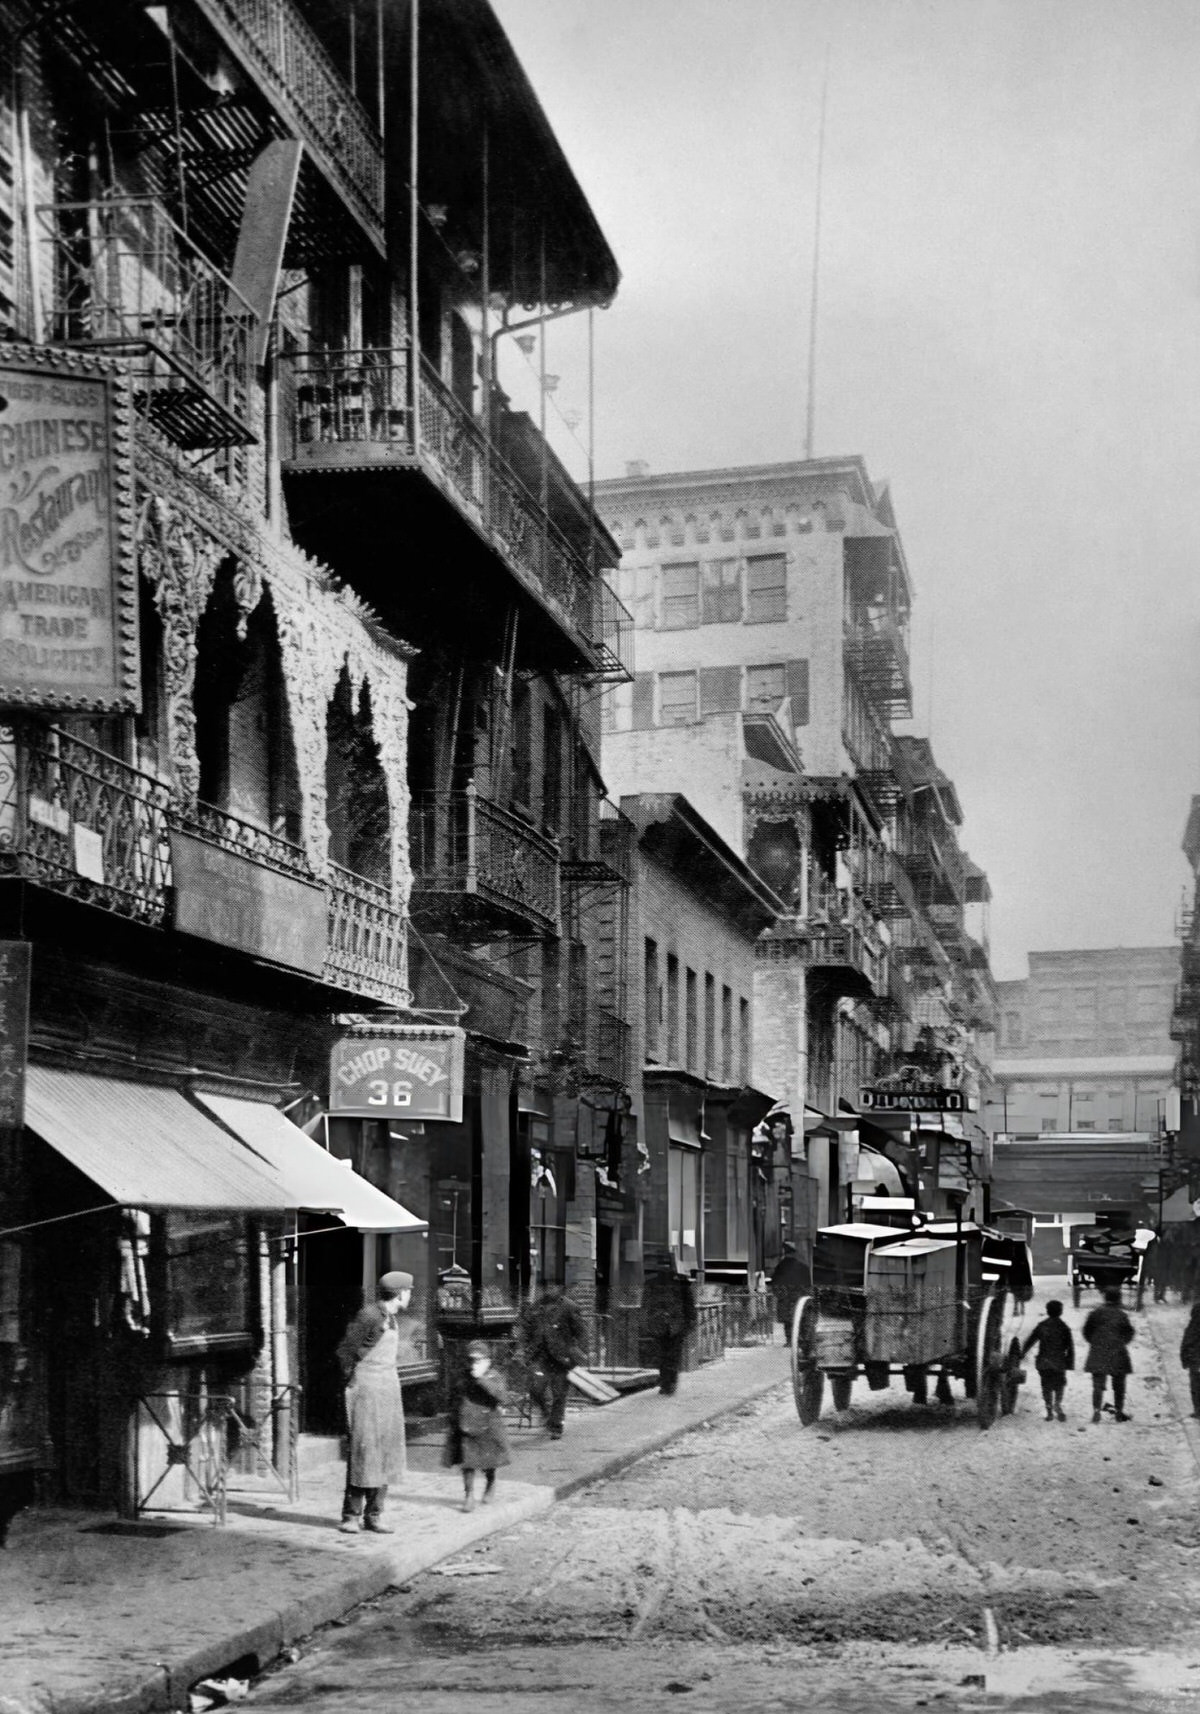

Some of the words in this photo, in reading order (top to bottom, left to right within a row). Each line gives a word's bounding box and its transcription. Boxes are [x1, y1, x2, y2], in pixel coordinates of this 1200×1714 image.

[0, 419, 105, 470] CHINESE
[0, 581, 106, 618] AMERICAN
[19, 614, 88, 639] TRADE
[337, 1047, 391, 1086] CHOP
[393, 1048, 449, 1087] SUEY
[367, 1079, 413, 1106] 36
